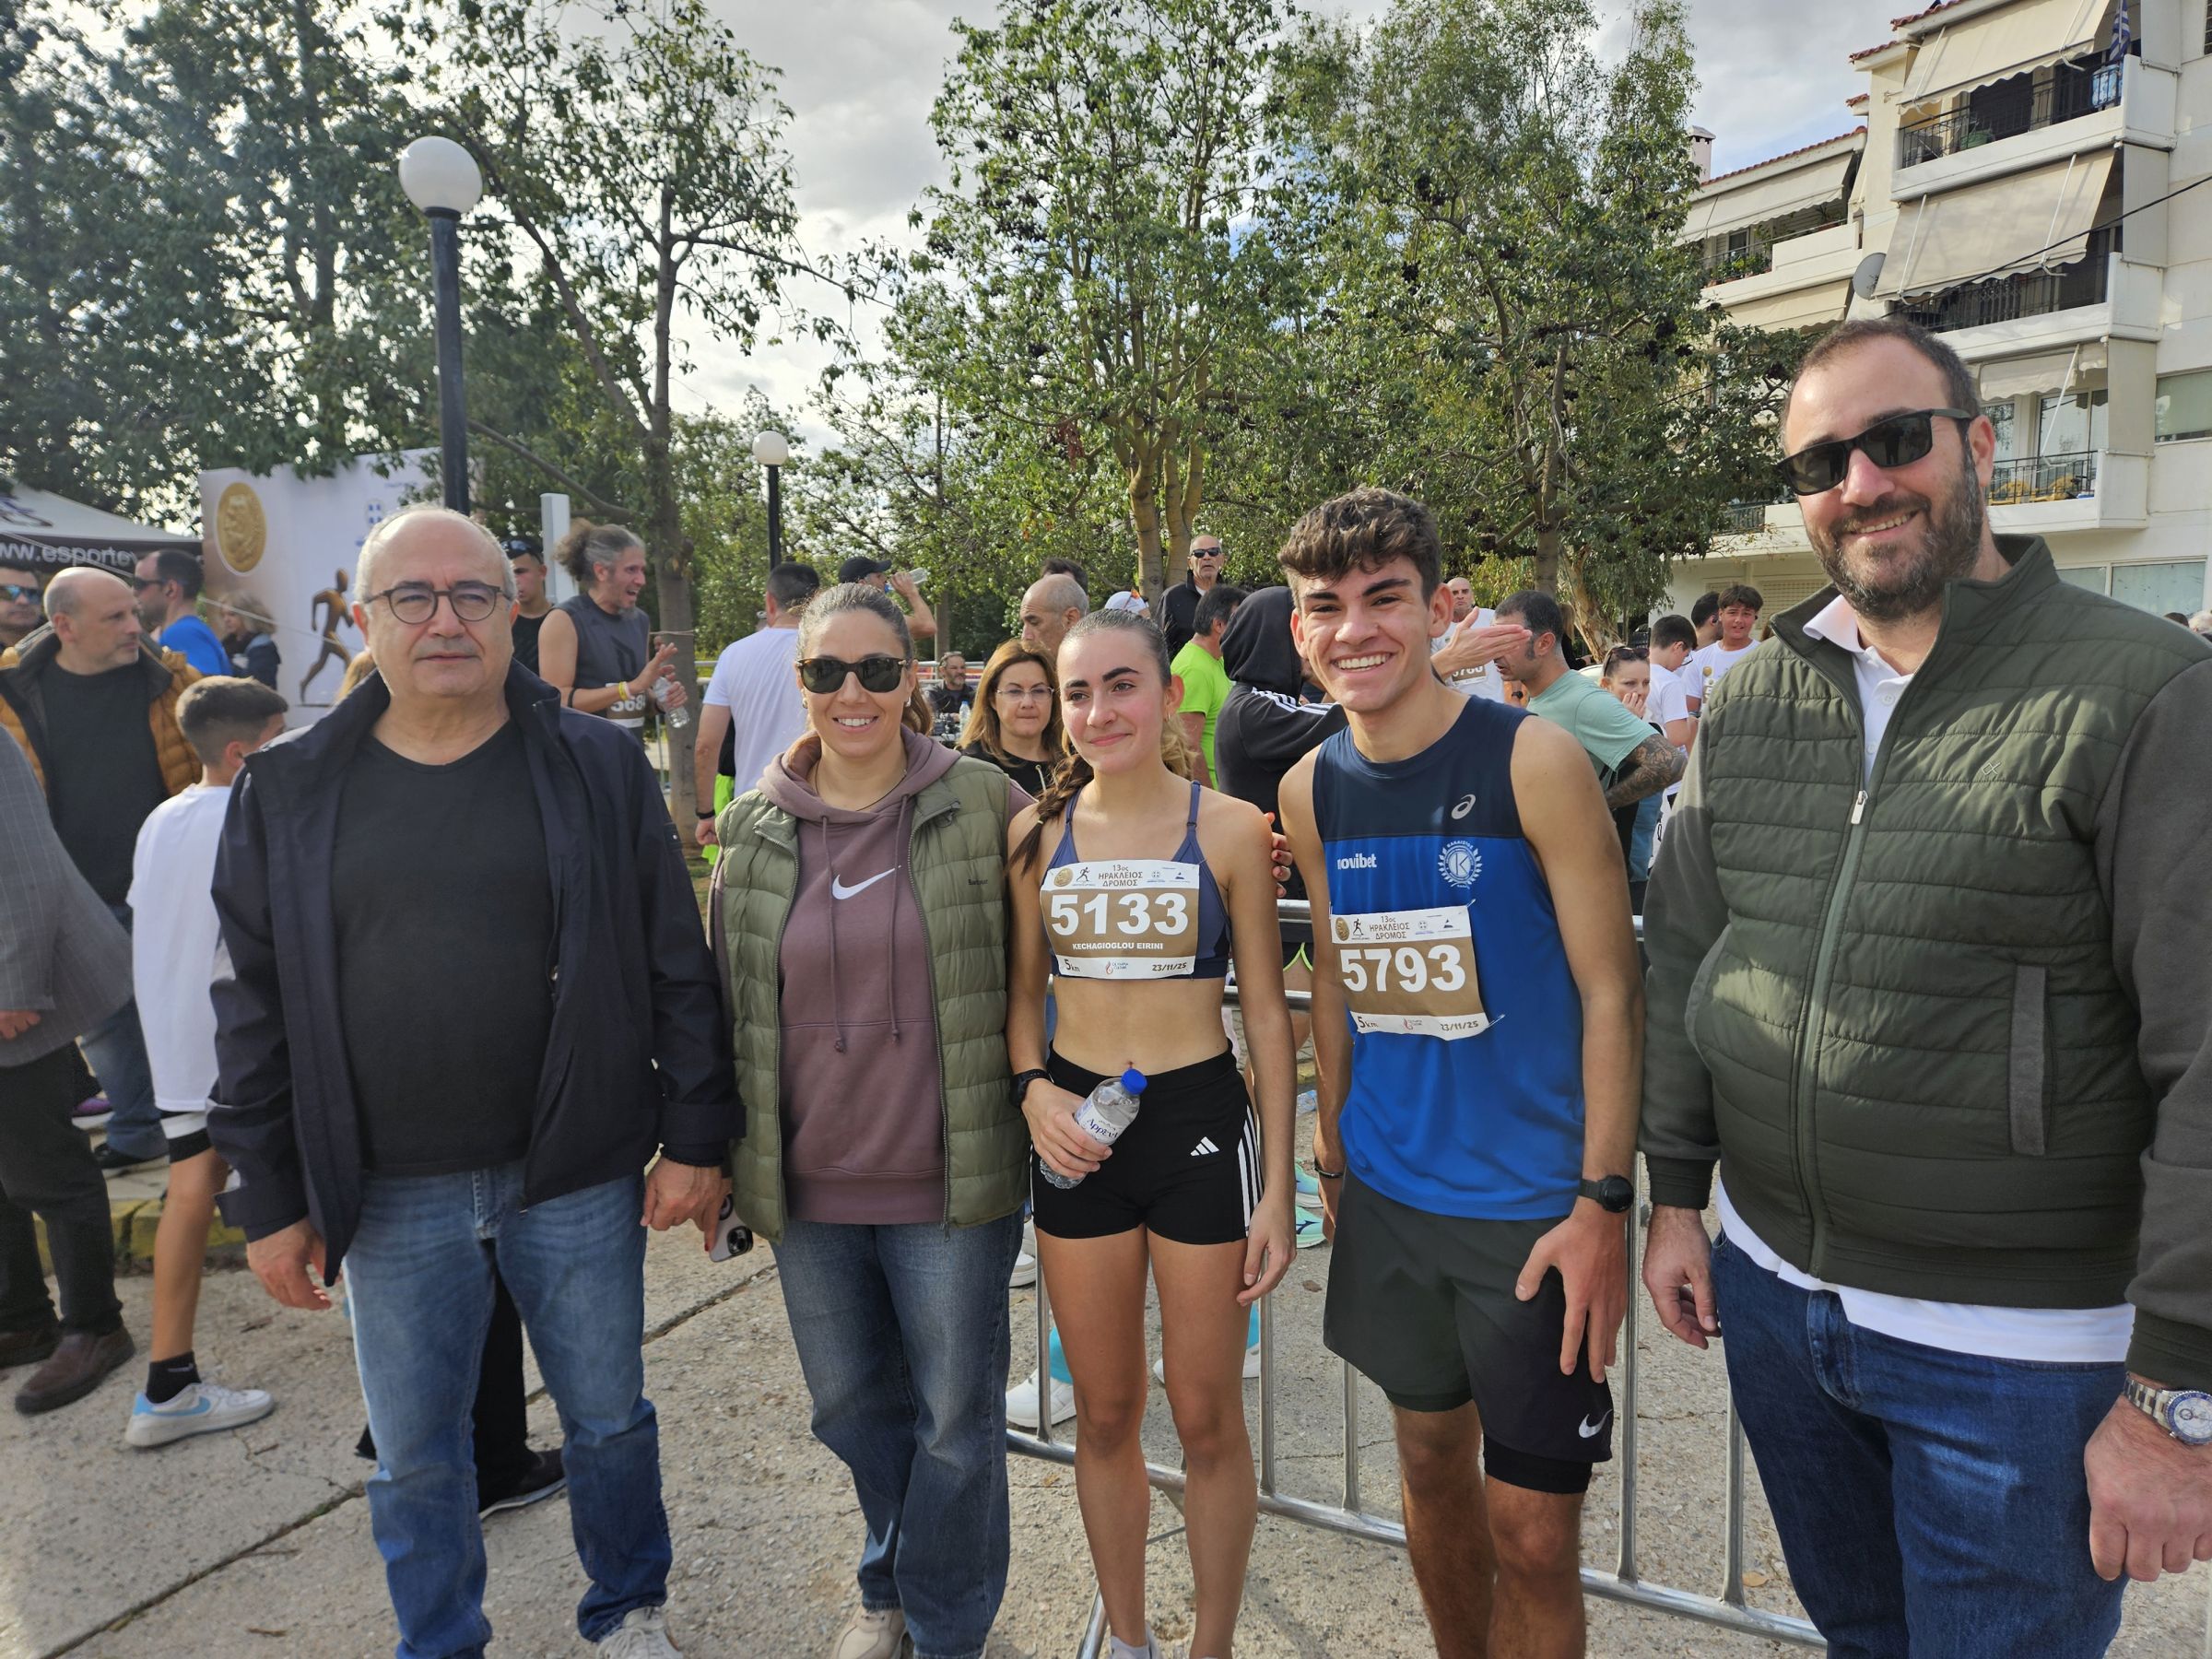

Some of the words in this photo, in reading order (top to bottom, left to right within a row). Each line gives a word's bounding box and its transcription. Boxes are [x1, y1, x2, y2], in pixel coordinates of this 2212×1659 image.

[1337, 853, 1377, 870] novibet
[1098, 871, 1143, 880] ΗΡΑΚΛΕΙΟΣ
[1102, 879, 1138, 888] ΔΡΟΜΟΣ
[1051, 892, 1189, 936] 5133
[1370, 922, 1410, 933] ΗΡΑΚΛΕΙΟΣ
[1375, 931, 1407, 940] ΔΡΟΜΟΣ
[1072, 942, 1135, 950] KECHAGIOGLOU
[1136, 942, 1163, 950] EIRINI
[1152, 961, 1187, 971] 23/11/25
[1339, 944, 1466, 993] 5793
